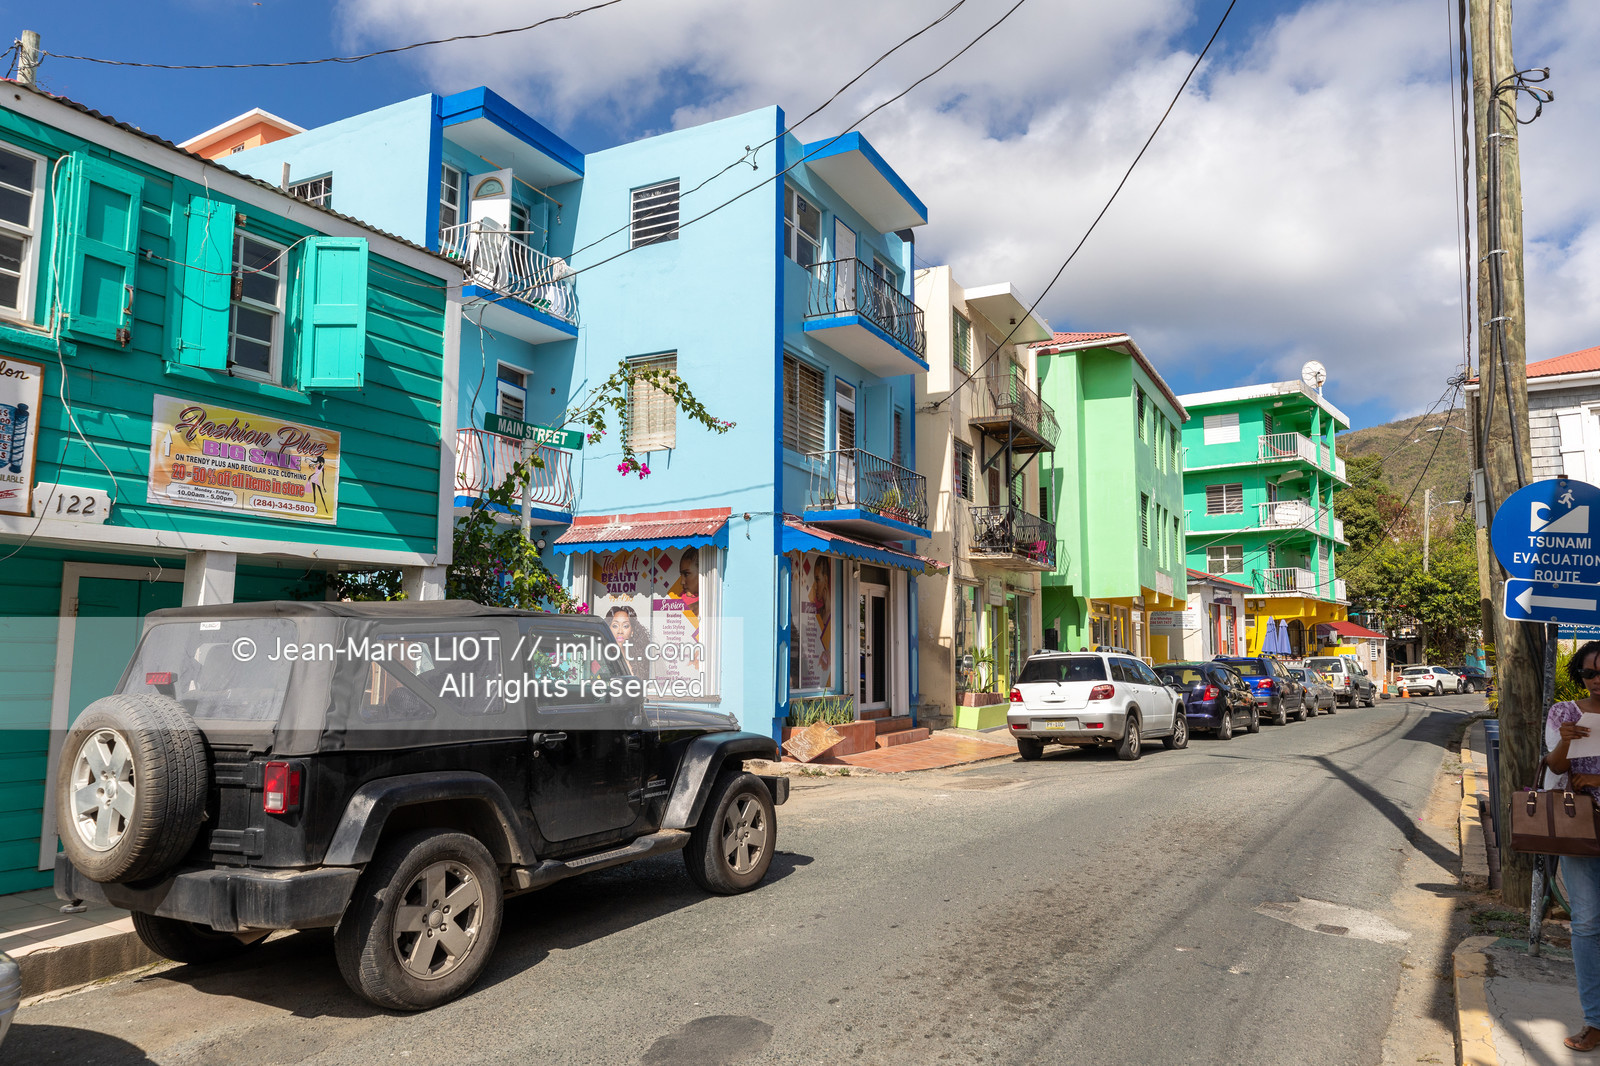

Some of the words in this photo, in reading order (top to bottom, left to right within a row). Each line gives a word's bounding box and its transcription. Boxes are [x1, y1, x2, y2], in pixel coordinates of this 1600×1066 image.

[175, 406, 272, 446] Fashion
[276, 426, 328, 456] Plus
[498, 418, 523, 437] MAIN
[526, 426, 568, 445] STREET
[202, 439, 246, 462] BIG
[250, 448, 301, 470] SALE
[176, 454, 184, 462] ON
[186, 454, 210, 465] TRENDY
[212, 458, 226, 468] PLUS
[228, 461, 240, 470] AND
[240, 464, 266, 474] REGULAR
[268, 468, 279, 477] SIZE
[281, 470, 307, 481] CLOTHING
[172, 463, 185, 480] 20
[192, 466, 207, 484] 50
[208, 468, 216, 485] %
[218, 470, 231, 487] off
[232, 473, 244, 488] all
[245, 475, 270, 493] items
[272, 479, 281, 494] in
[282, 481, 305, 497] store
[178, 490, 205, 498] 10.00am
[56, 493, 96, 515] 122
[253, 498, 315, 514] (284)-343-5803
[1528, 536, 1592, 549] TSUNAMI
[603, 555, 618, 576] This
[1513, 552, 1600, 567] EVACUATION
[601, 572, 639, 583] BEAUTY
[1535, 570, 1580, 583] ROUTE
[606, 583, 636, 593] SALON
